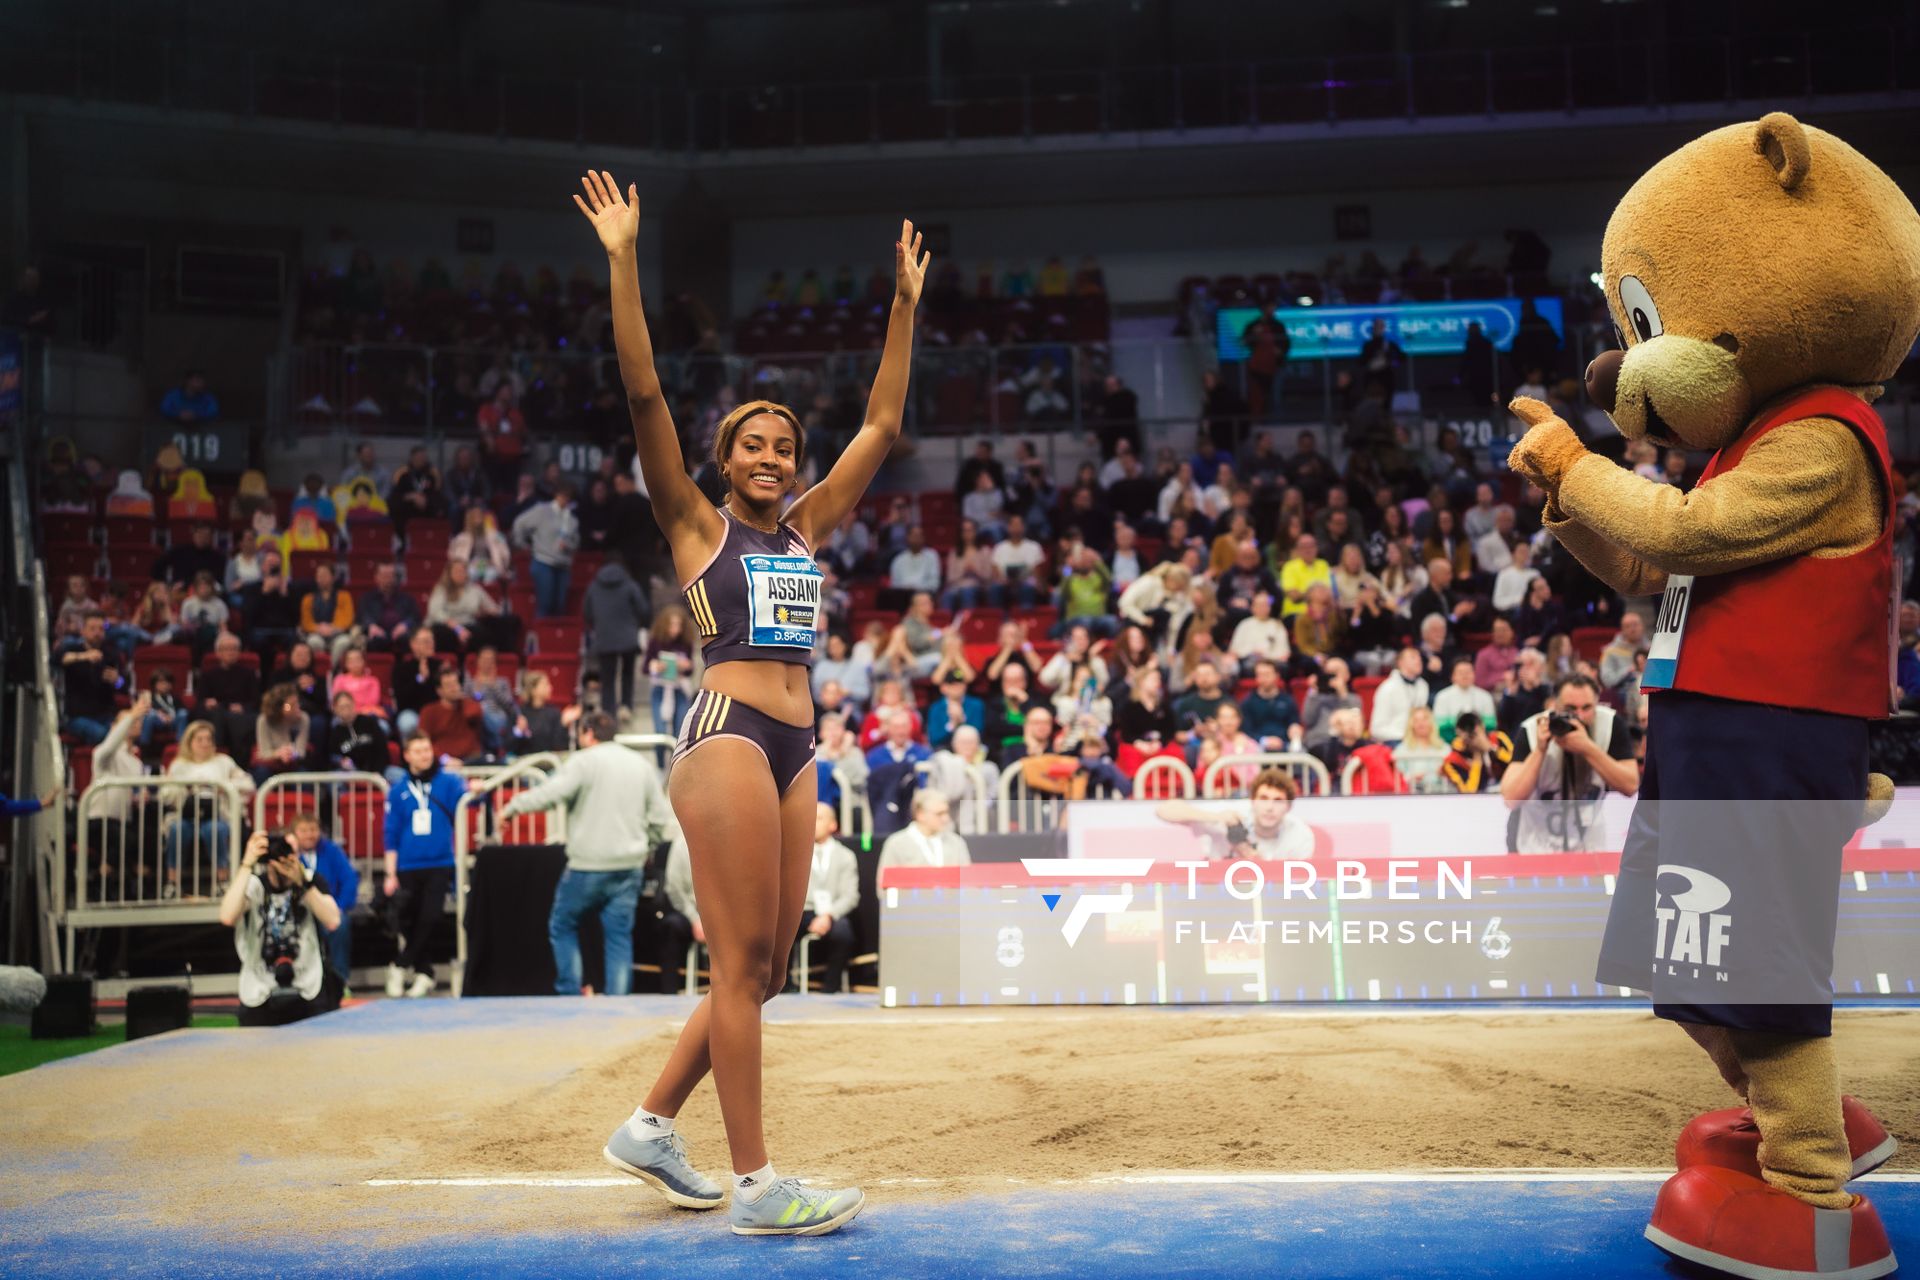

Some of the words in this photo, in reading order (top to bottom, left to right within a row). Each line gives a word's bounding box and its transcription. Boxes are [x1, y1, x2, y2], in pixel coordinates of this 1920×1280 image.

[768, 576, 818, 603] ASSANI
[997, 926, 1024, 967] 8
[1480, 916, 1512, 959] 6
